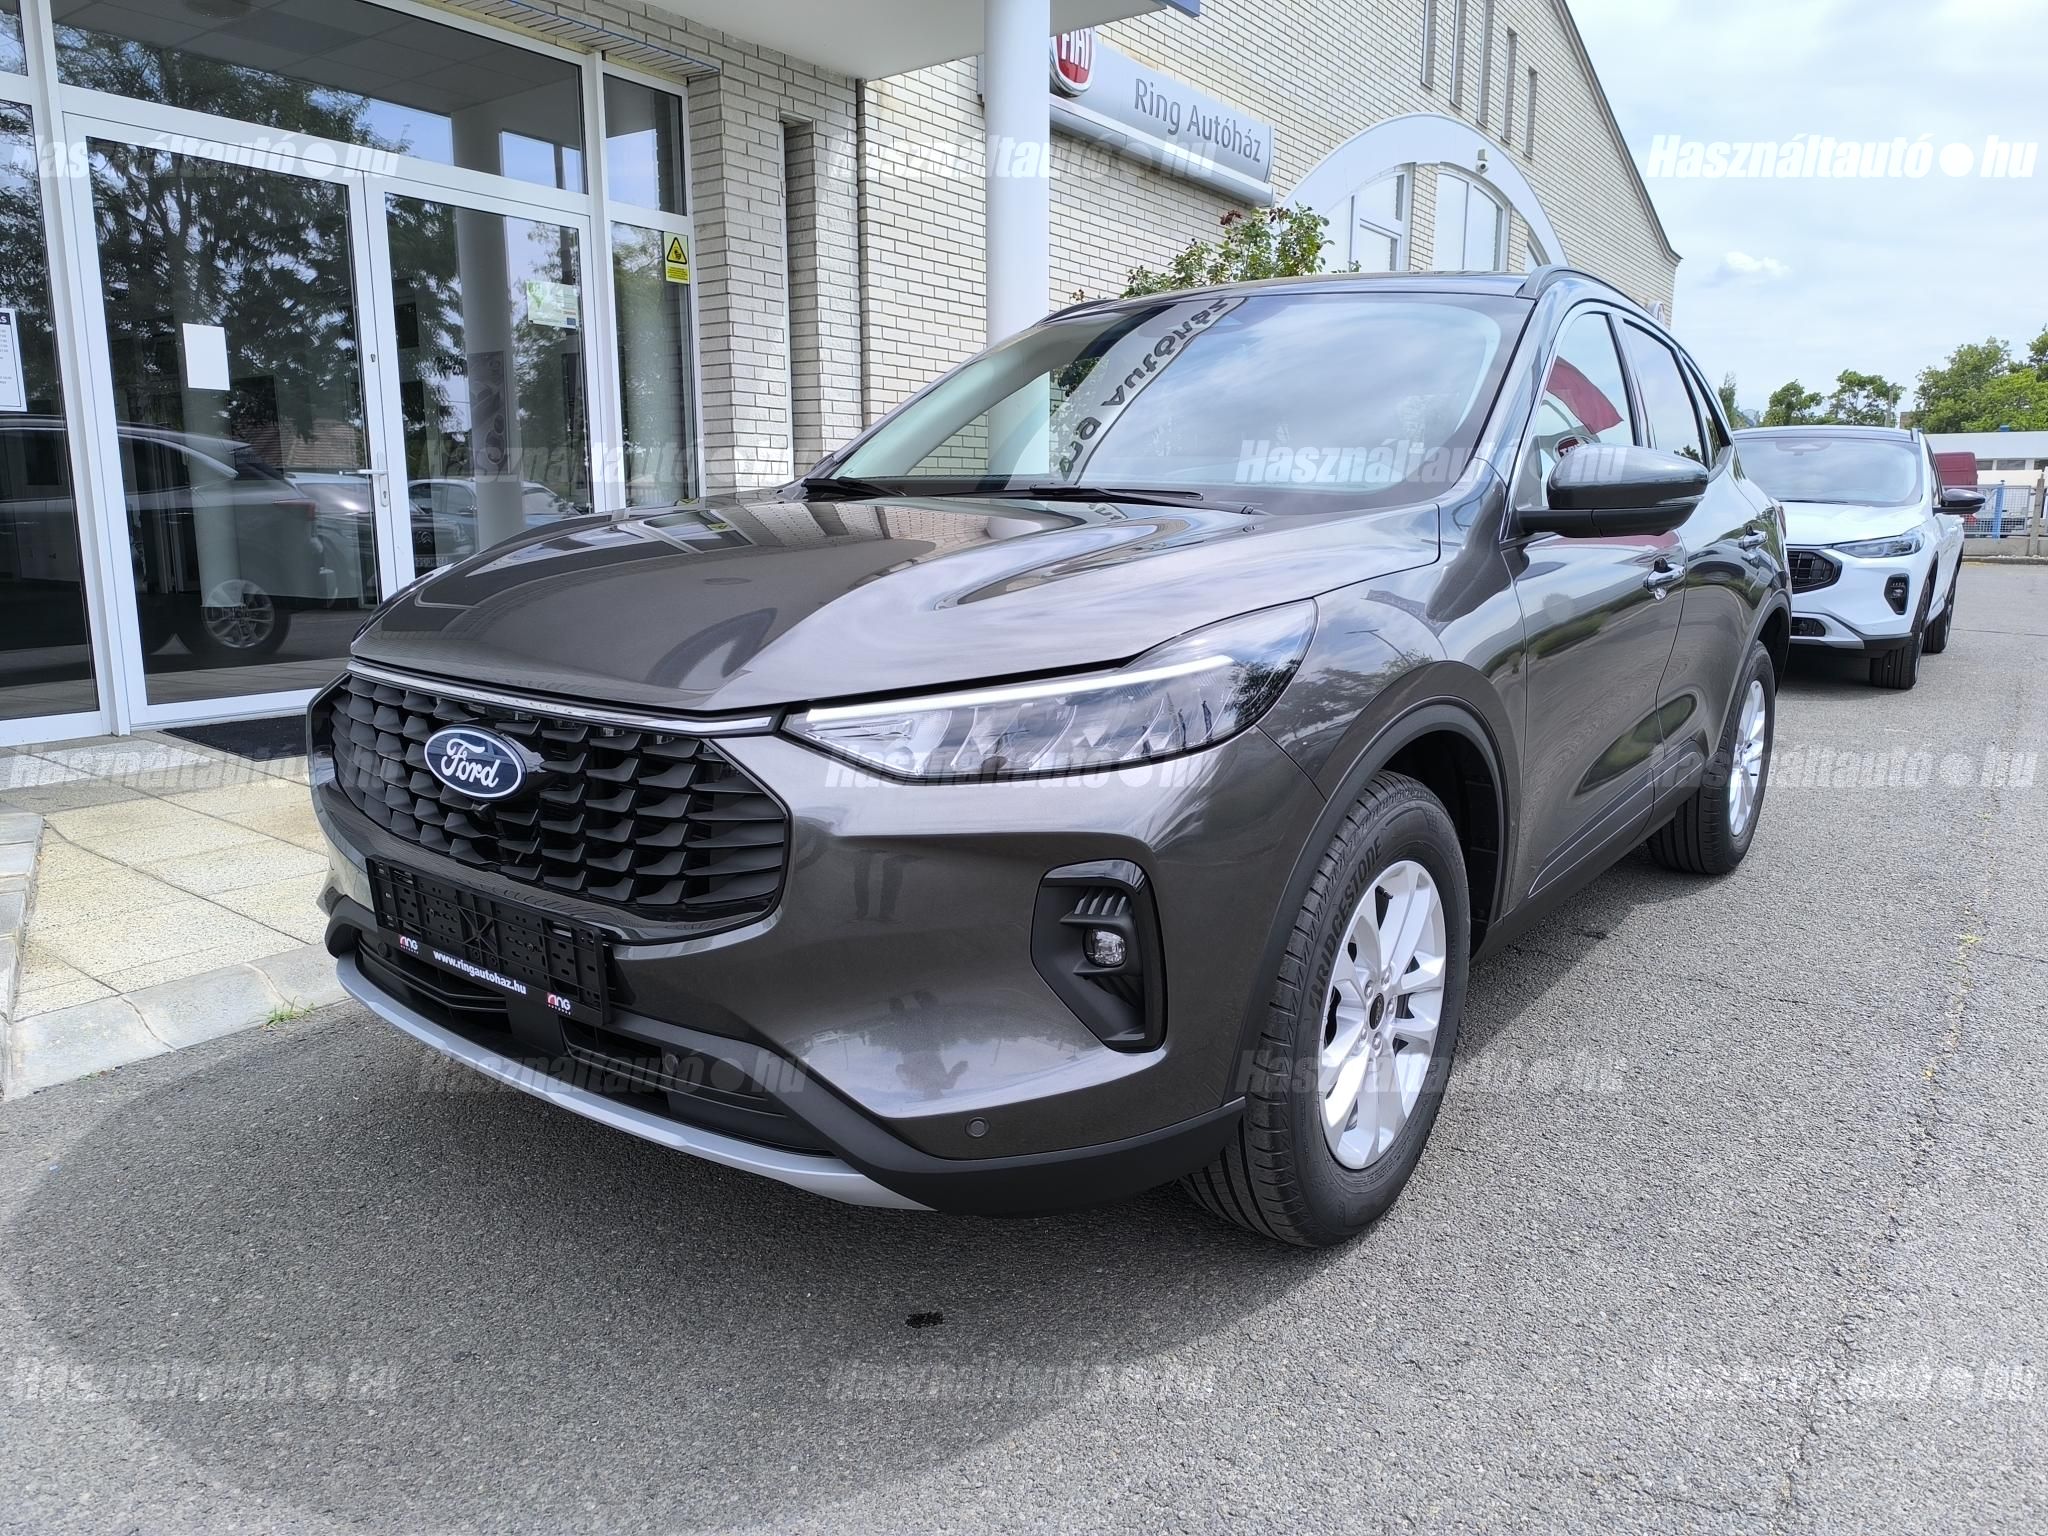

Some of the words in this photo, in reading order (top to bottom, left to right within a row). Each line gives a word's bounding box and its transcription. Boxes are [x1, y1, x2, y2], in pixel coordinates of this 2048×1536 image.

[1061, 27, 1093, 70] FIAT
[1133, 78, 1181, 135] Ring
[1187, 105, 1261, 163] Autóház
[441, 738, 501, 788] Ford
[1308, 835, 1383, 1010] BRIDGESTONE
[432, 950, 527, 995] www.ringautohaz.hu
